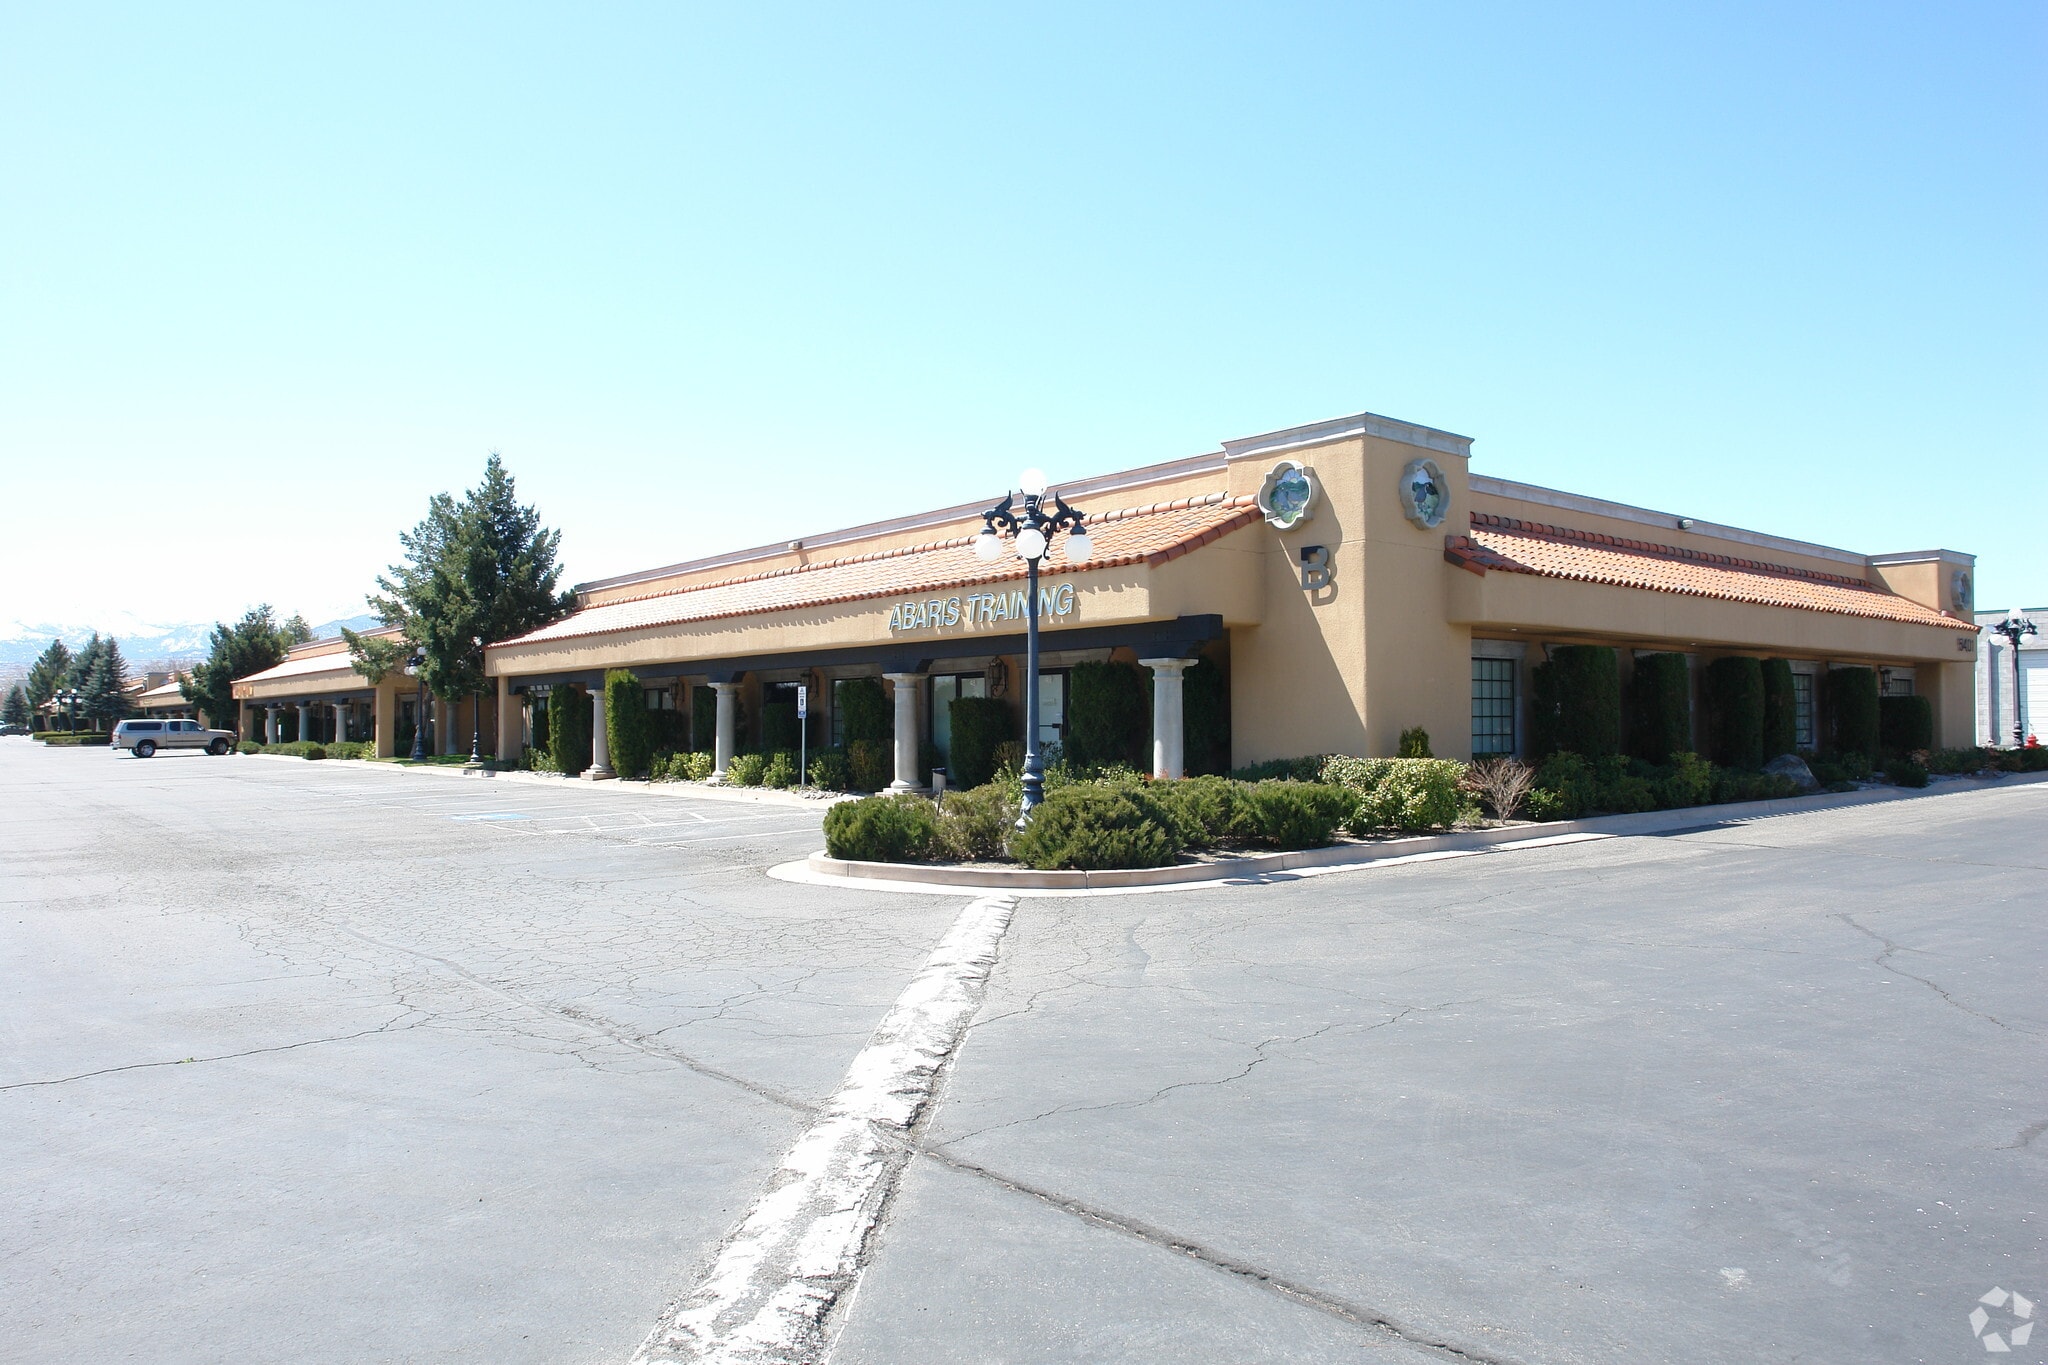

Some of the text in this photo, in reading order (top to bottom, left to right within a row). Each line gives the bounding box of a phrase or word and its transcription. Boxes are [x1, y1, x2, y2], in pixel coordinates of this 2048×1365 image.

[1301, 545, 1329, 590] B
[889, 583, 1074, 631] ABARIS TRAINNG
